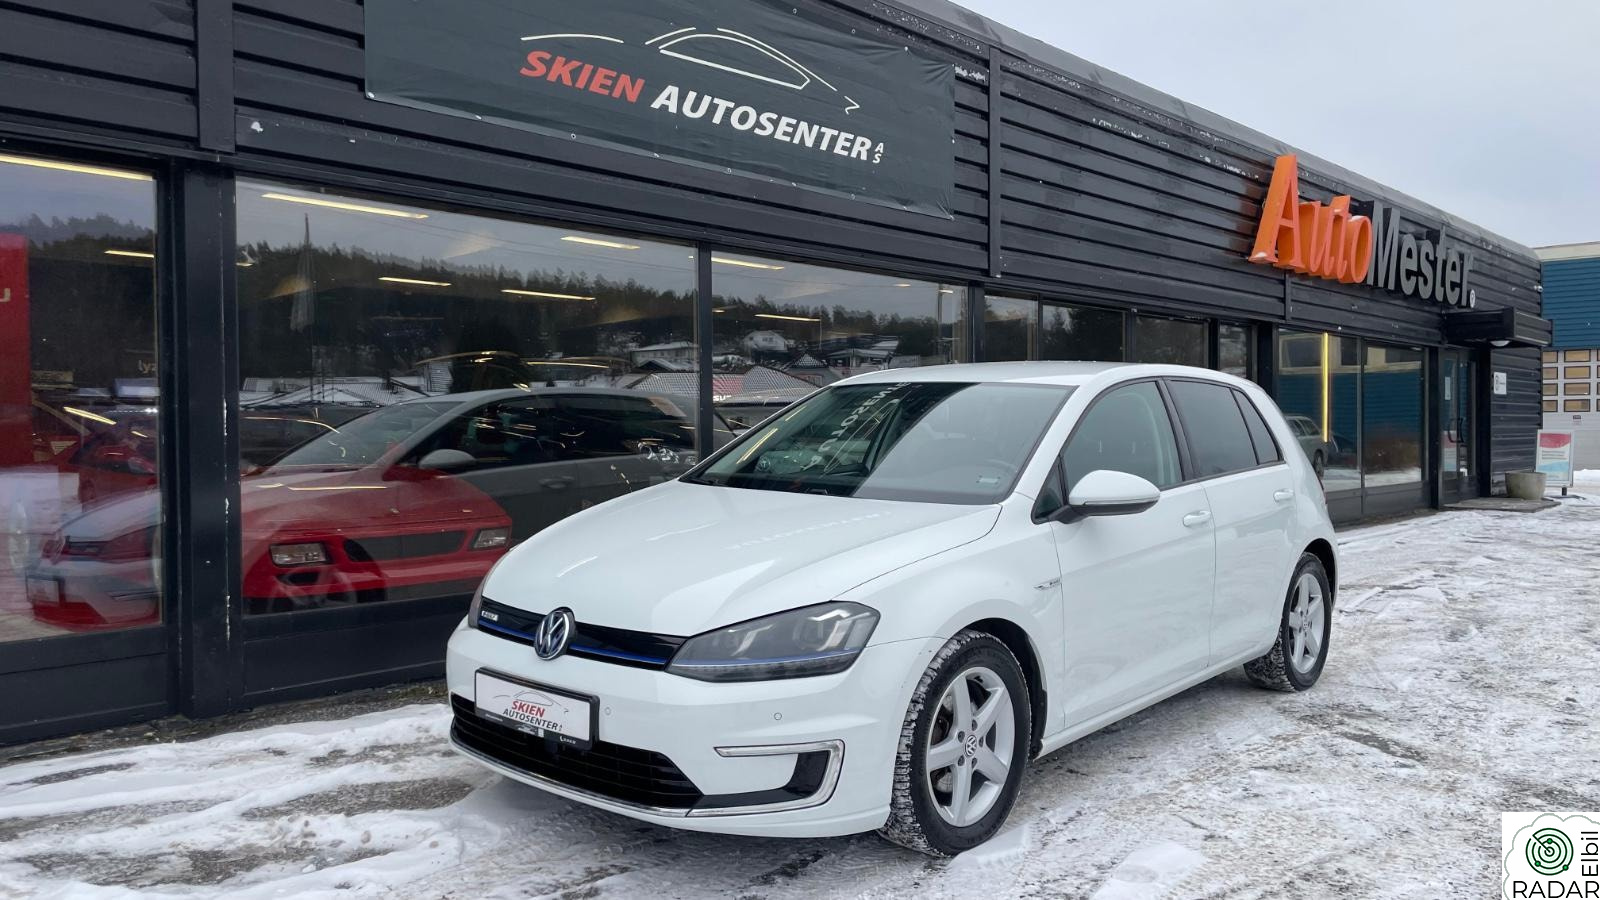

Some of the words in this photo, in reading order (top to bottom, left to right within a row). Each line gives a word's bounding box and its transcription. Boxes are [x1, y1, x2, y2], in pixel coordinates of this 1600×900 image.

[520, 50, 645, 103] SKIEN
[650, 85, 872, 161] AUTOSENTER
[503, 708, 559, 731] AUTOSENTER
[511, 700, 546, 718] SKIEN
